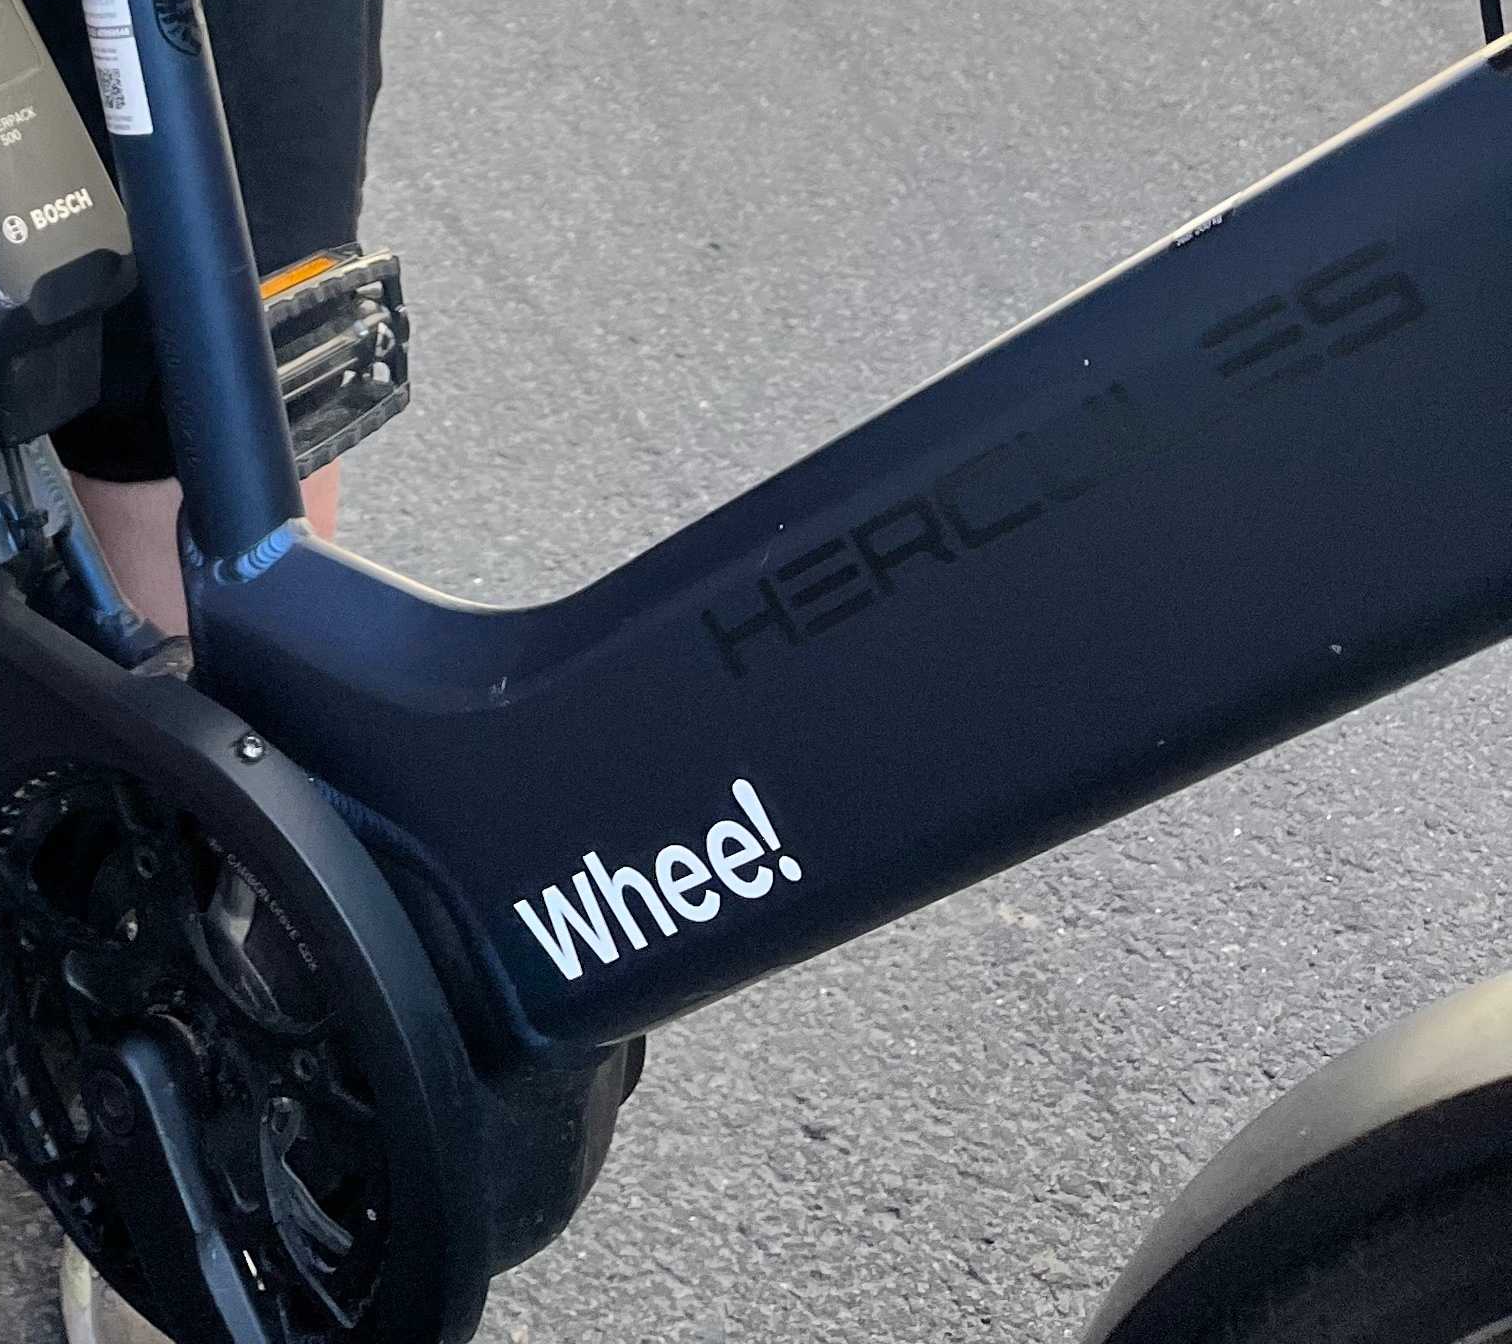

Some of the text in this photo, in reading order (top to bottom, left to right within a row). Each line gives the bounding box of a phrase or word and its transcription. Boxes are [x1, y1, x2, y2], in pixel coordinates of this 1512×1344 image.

[0, 129, 23, 146] 500
[29, 188, 93, 230] BOSCH
[698, 238, 1429, 679] HERCES
[513, 778, 802, 980] Whee!
